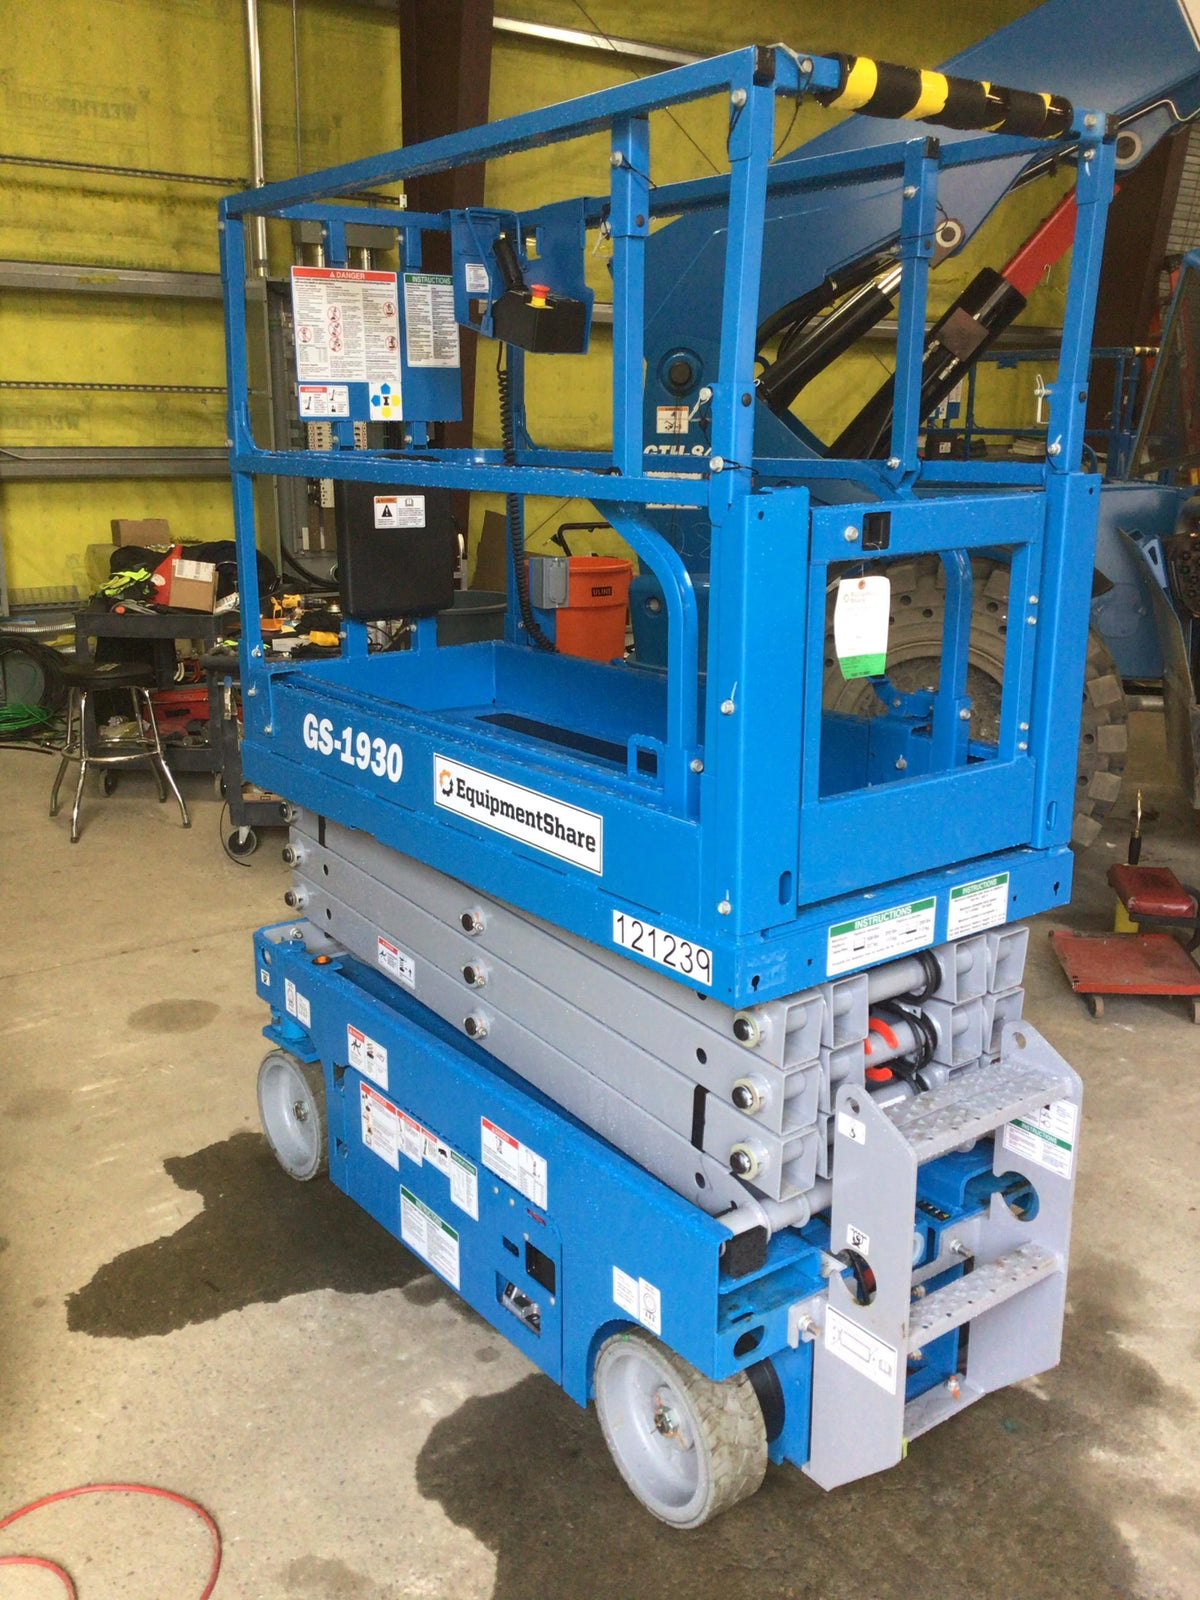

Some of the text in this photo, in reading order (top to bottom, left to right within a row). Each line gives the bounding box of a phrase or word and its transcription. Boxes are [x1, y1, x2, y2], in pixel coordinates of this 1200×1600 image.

[336, 271, 366, 280] DANGER
[412, 275, 452, 285] INSTRUCTIONS
[644, 444, 712, 456] GTH-8
[303, 713, 403, 783] GS-1930
[456, 777, 596, 853] EquipmentShare
[962, 878, 997, 895] INSTRUCTIONS
[854, 905, 912, 930] INSTRUCTIONS
[617, 914, 710, 983] 121239
